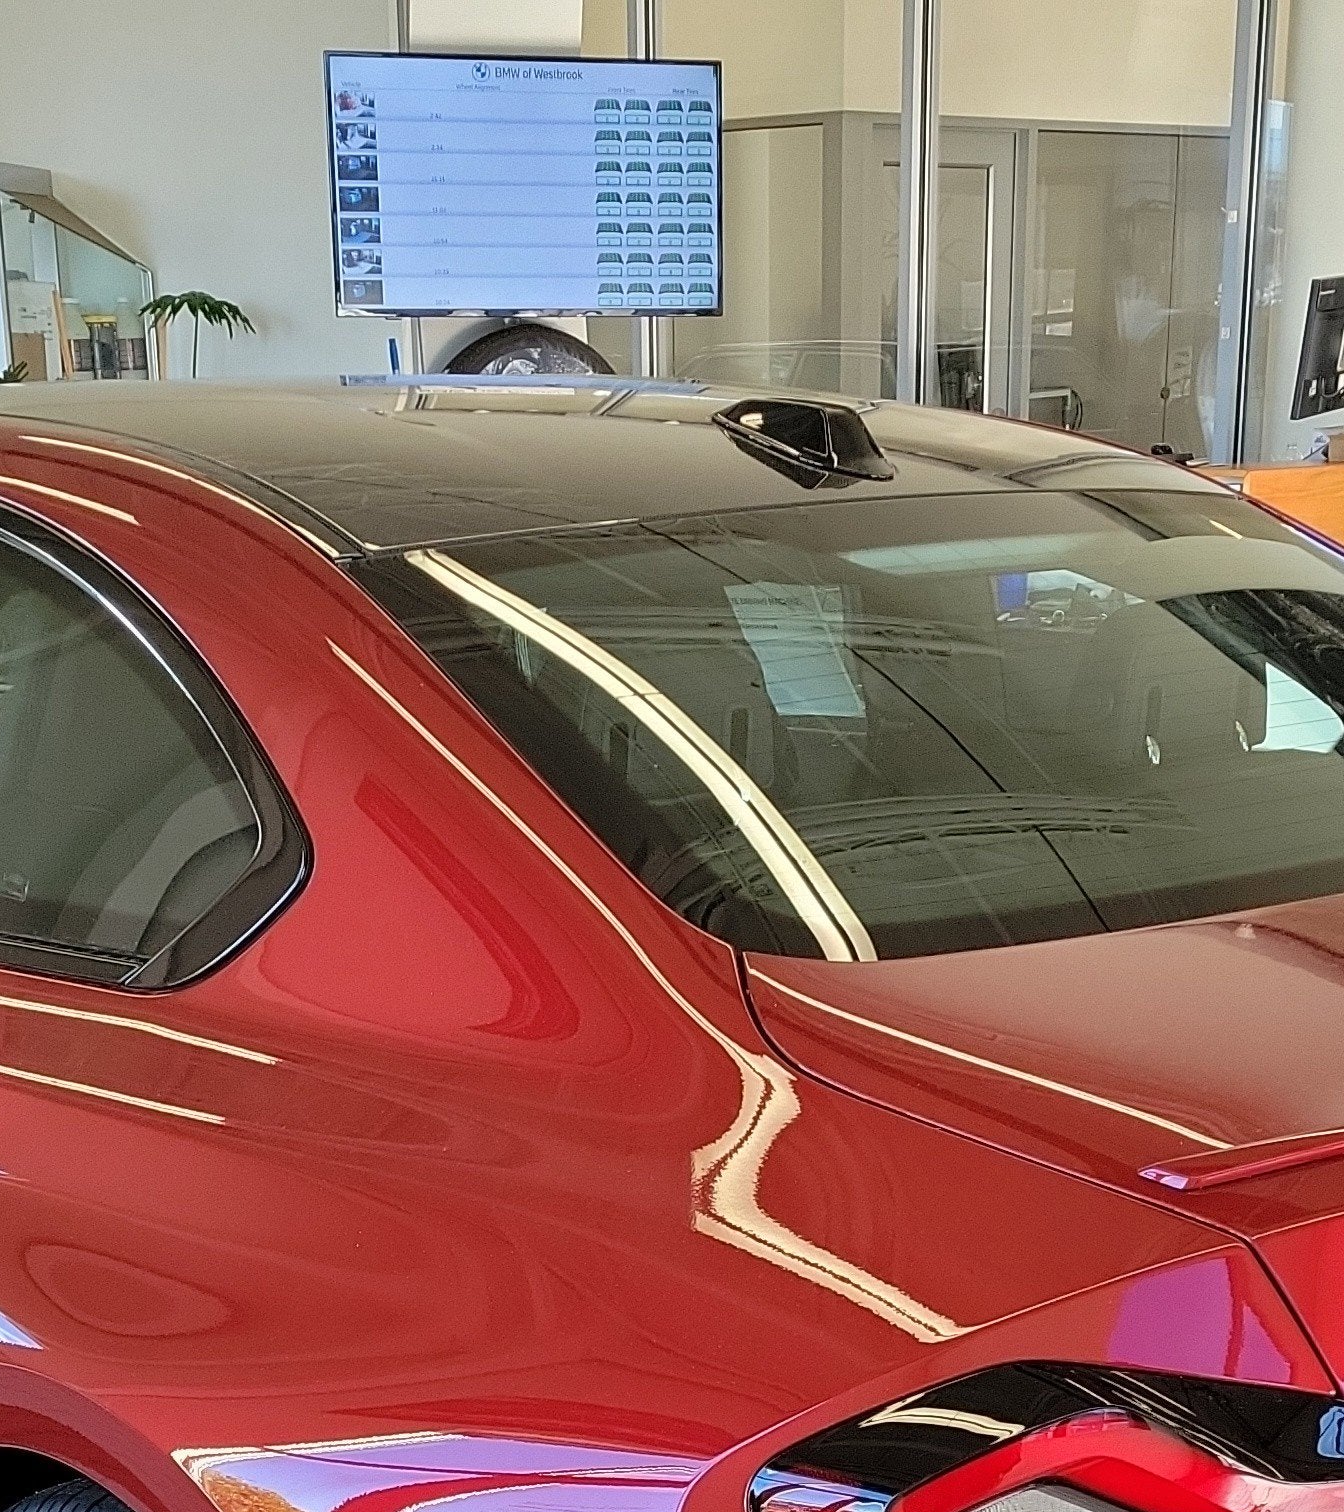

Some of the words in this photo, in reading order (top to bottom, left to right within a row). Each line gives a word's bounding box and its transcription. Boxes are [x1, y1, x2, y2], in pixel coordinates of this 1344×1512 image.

[495, 67, 520, 78] BMW
[522, 68, 531, 79] of
[533, 68, 584, 80] Westbrook
